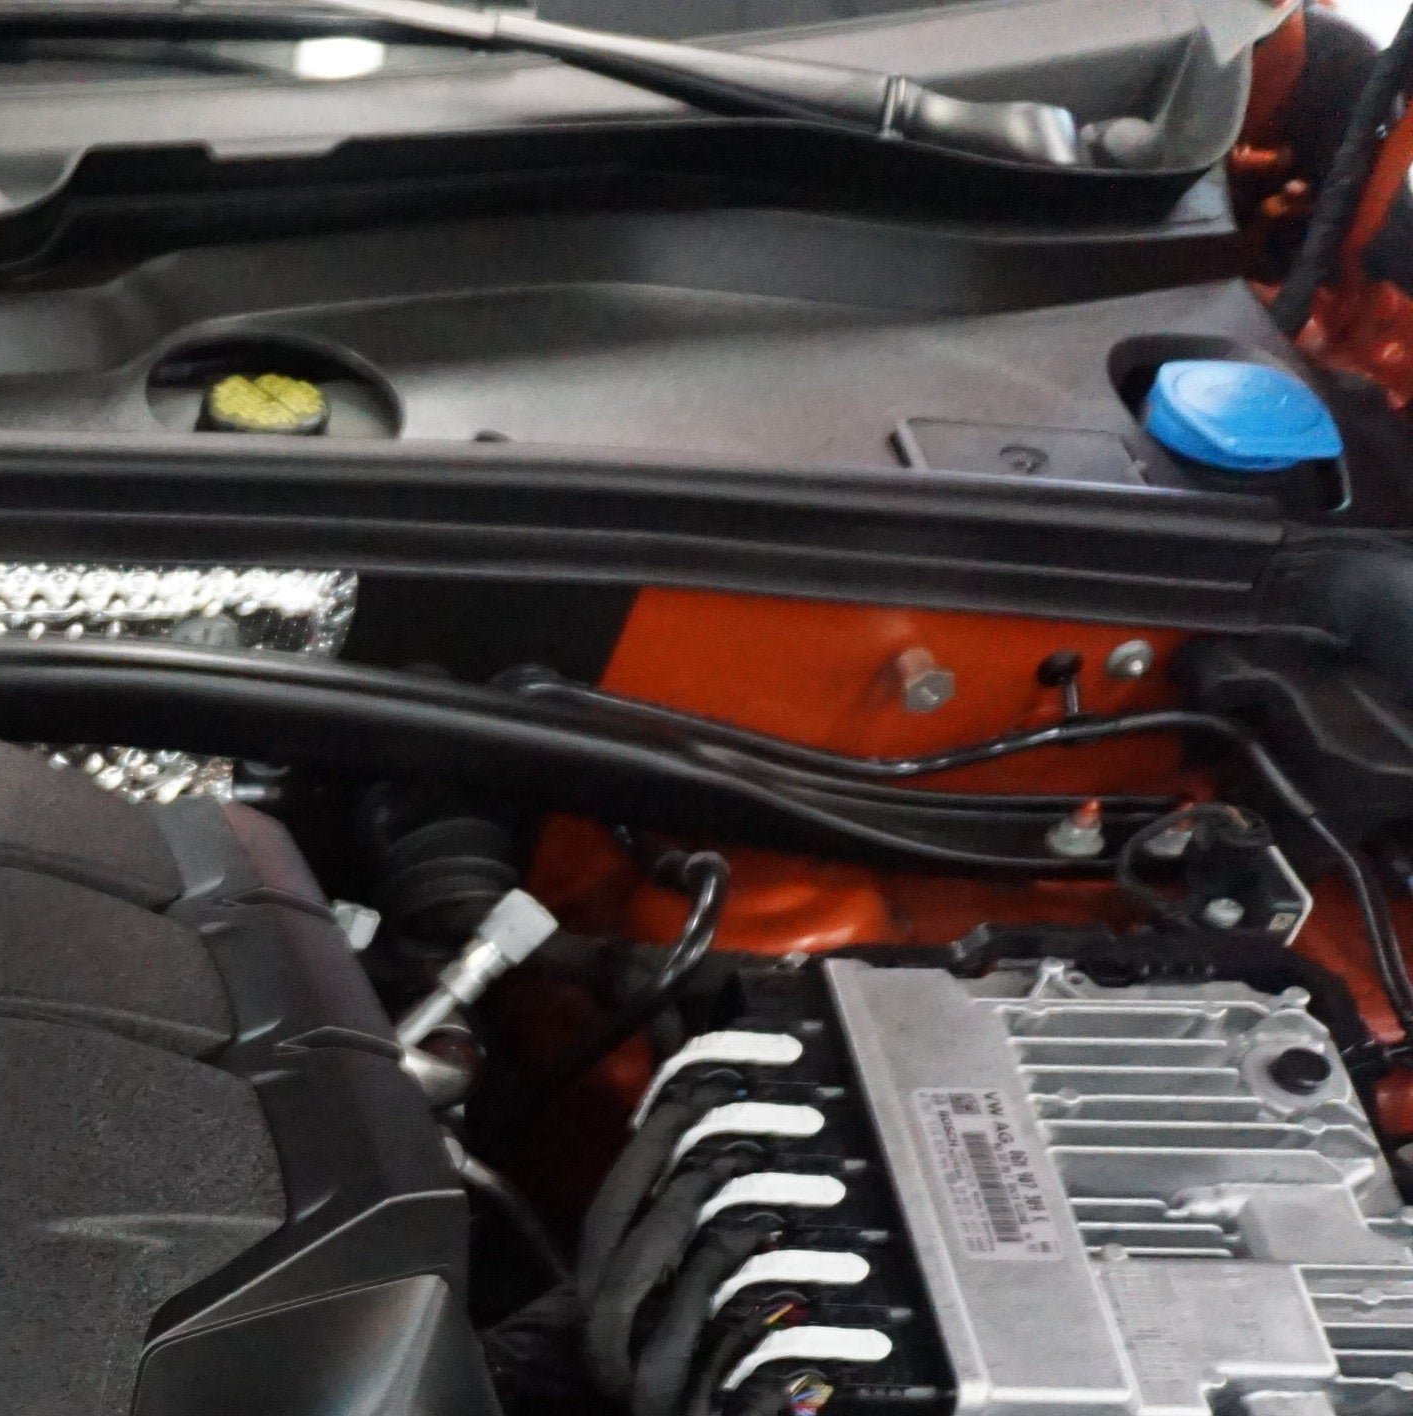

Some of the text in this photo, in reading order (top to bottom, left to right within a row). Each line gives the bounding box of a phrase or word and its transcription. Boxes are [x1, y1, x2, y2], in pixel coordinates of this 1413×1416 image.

[984, 1091, 1005, 1116] VW
[938, 1110, 959, 1147] BOSCH
[993, 1121, 1014, 1144] AG
